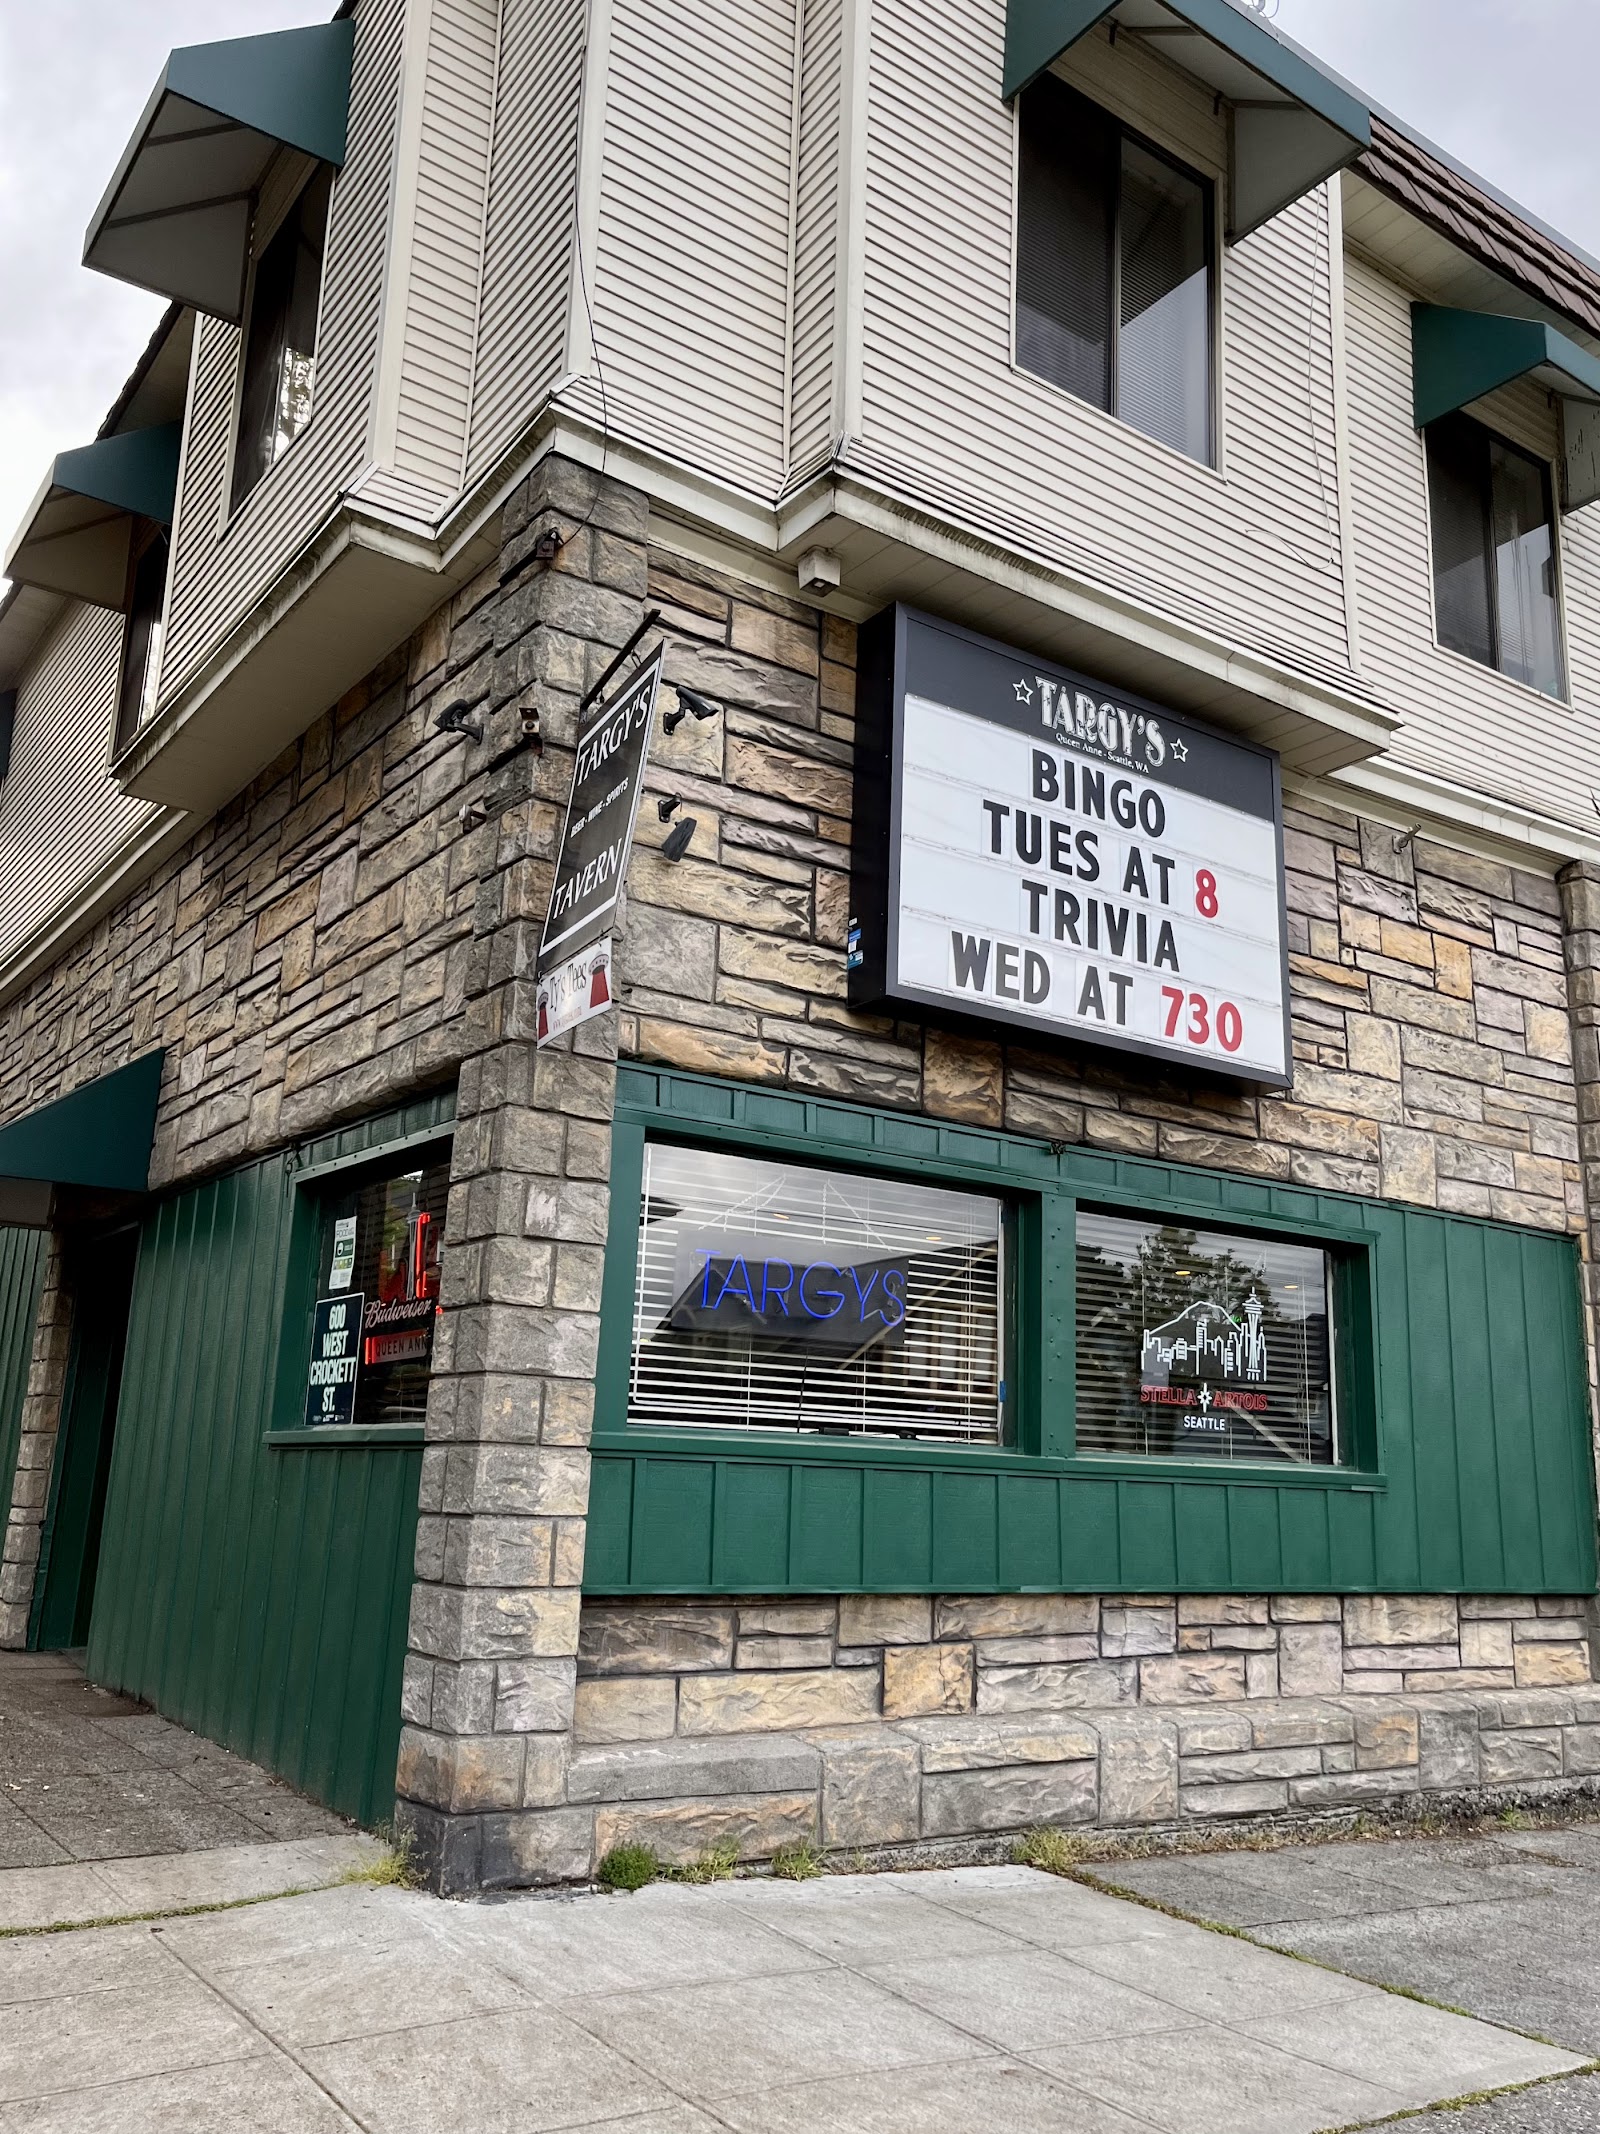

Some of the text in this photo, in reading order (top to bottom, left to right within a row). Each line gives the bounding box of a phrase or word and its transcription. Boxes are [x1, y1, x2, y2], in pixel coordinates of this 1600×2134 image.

[577, 684, 652, 786] TARGY'S
[1035, 675, 1166, 767] TARGY'S
[1055, 732, 1081, 749] Queen
[1082, 741, 1103, 757] Anne
[1134, 760, 1149, 773] WA
[1032, 748, 1166, 838] BINGO
[553, 837, 623, 920] TAVERN
[983, 799, 1219, 919] TUES AT 8
[1021, 879, 1180, 973] TRIVIA
[951, 931, 1243, 1052] WED AT 730
[696, 1249, 905, 1326] TARGYS
[328, 1303, 347, 1330] 600
[364, 1298, 432, 1329] Budweiser
[322, 1330, 349, 1357] WEST
[375, 1341, 405, 1355] QUEEN
[309, 1356, 357, 1386] CROCKETT
[321, 1386, 336, 1412] ST.
[1140, 1384, 1268, 1411] STELLA ARTOIS
[1183, 1415, 1226, 1431] SEATTLE
